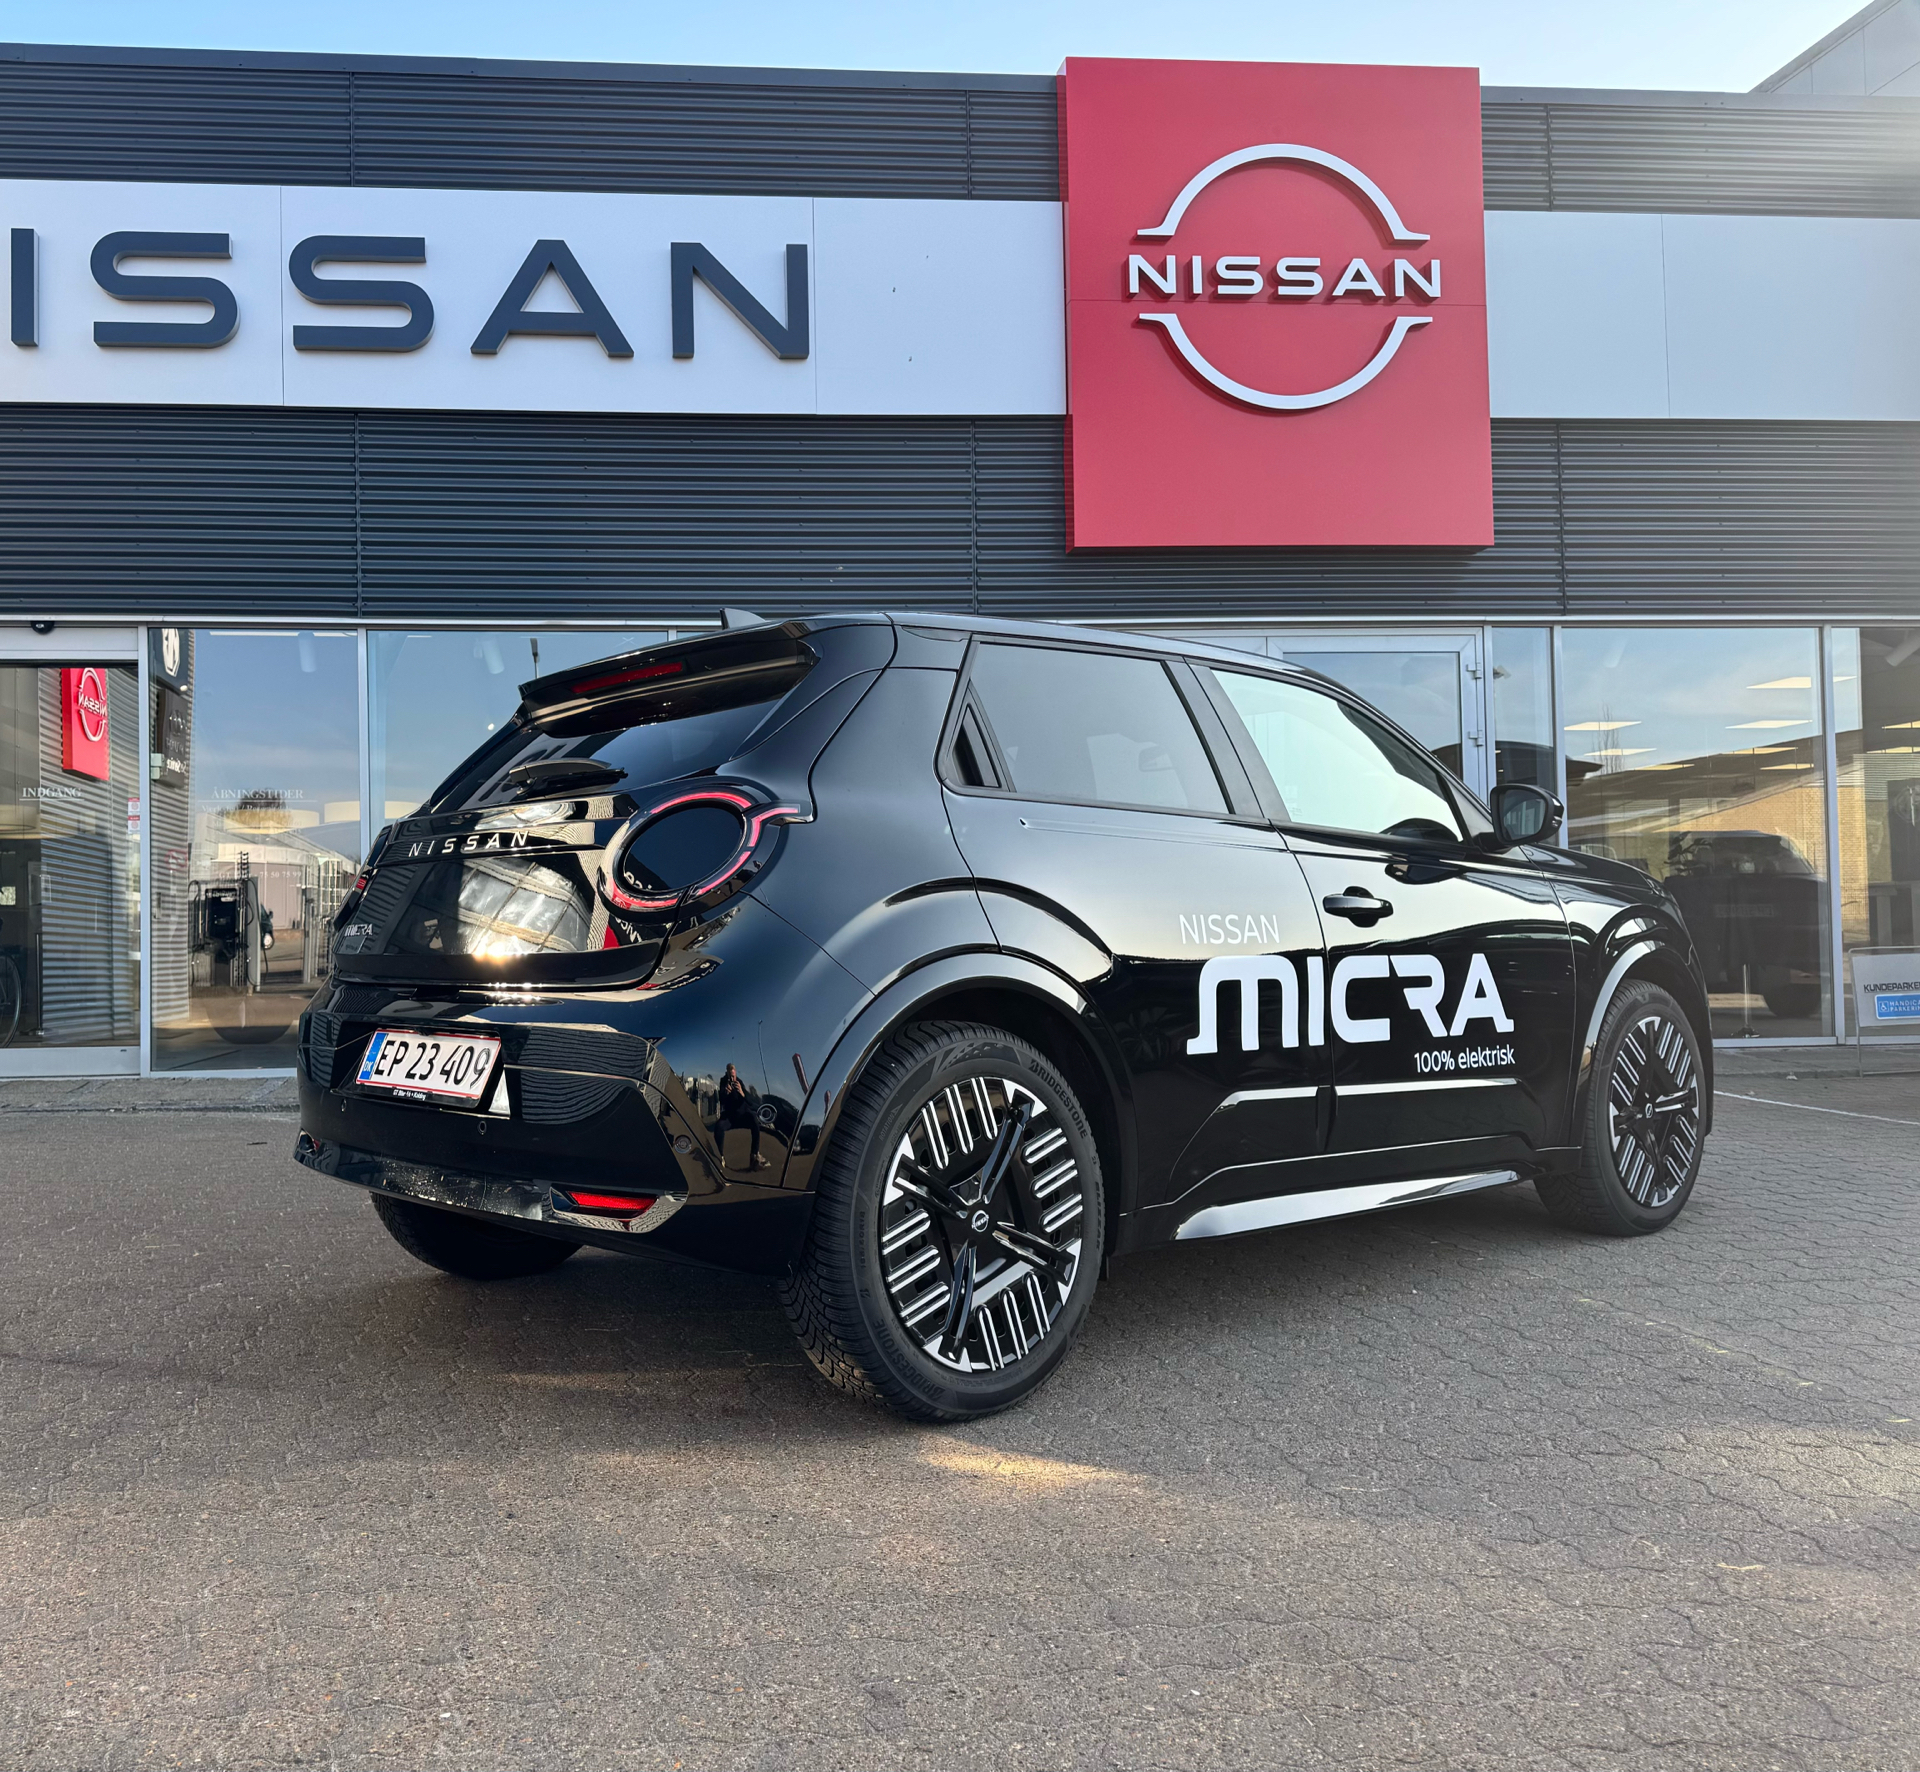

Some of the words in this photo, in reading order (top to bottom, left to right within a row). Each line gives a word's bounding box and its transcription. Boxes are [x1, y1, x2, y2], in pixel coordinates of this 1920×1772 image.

[1126, 254, 1442, 299] NISSAN
[10, 227, 809, 360] ISSAN
[22, 787, 82, 798] INDGANG
[211, 786, 304, 800] ÅBNINGSTIDER
[408, 830, 529, 858] NISSAN
[344, 923, 373, 937] MICRA
[1178, 914, 1280, 944] NISSAN
[1863, 982, 1920, 993] KUNDEPARKE
[1186, 953, 1515, 1055] MICRA
[363, 1061, 374, 1072] DK
[374, 1040, 409, 1077] EP
[405, 1042, 441, 1080] 23
[440, 1045, 491, 1089] 409
[1413, 1052, 1455, 1073] 100%
[1457, 1045, 1516, 1069] elektrisk
[1028, 1058, 1088, 1139] BRIDGESTONE
[873, 1318, 946, 1399] BRIDGESTONE
